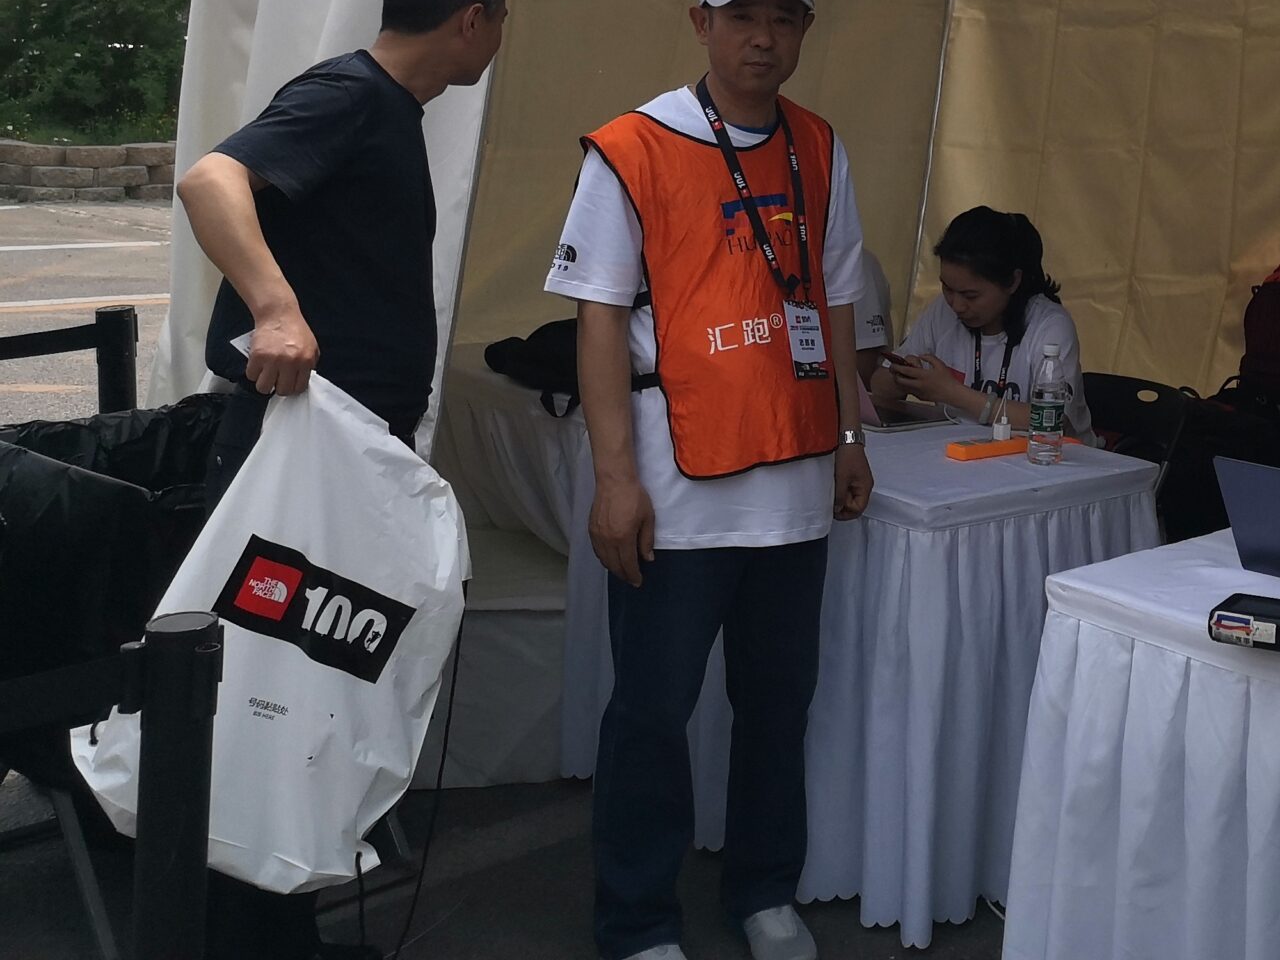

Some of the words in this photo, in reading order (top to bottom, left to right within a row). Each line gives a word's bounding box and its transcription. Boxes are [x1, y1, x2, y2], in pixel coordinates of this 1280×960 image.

[249, 579, 277, 593] NORTH
[264, 577, 278, 587] THE
[252, 588, 273, 599] FACE
[301, 585, 388, 654] 100
